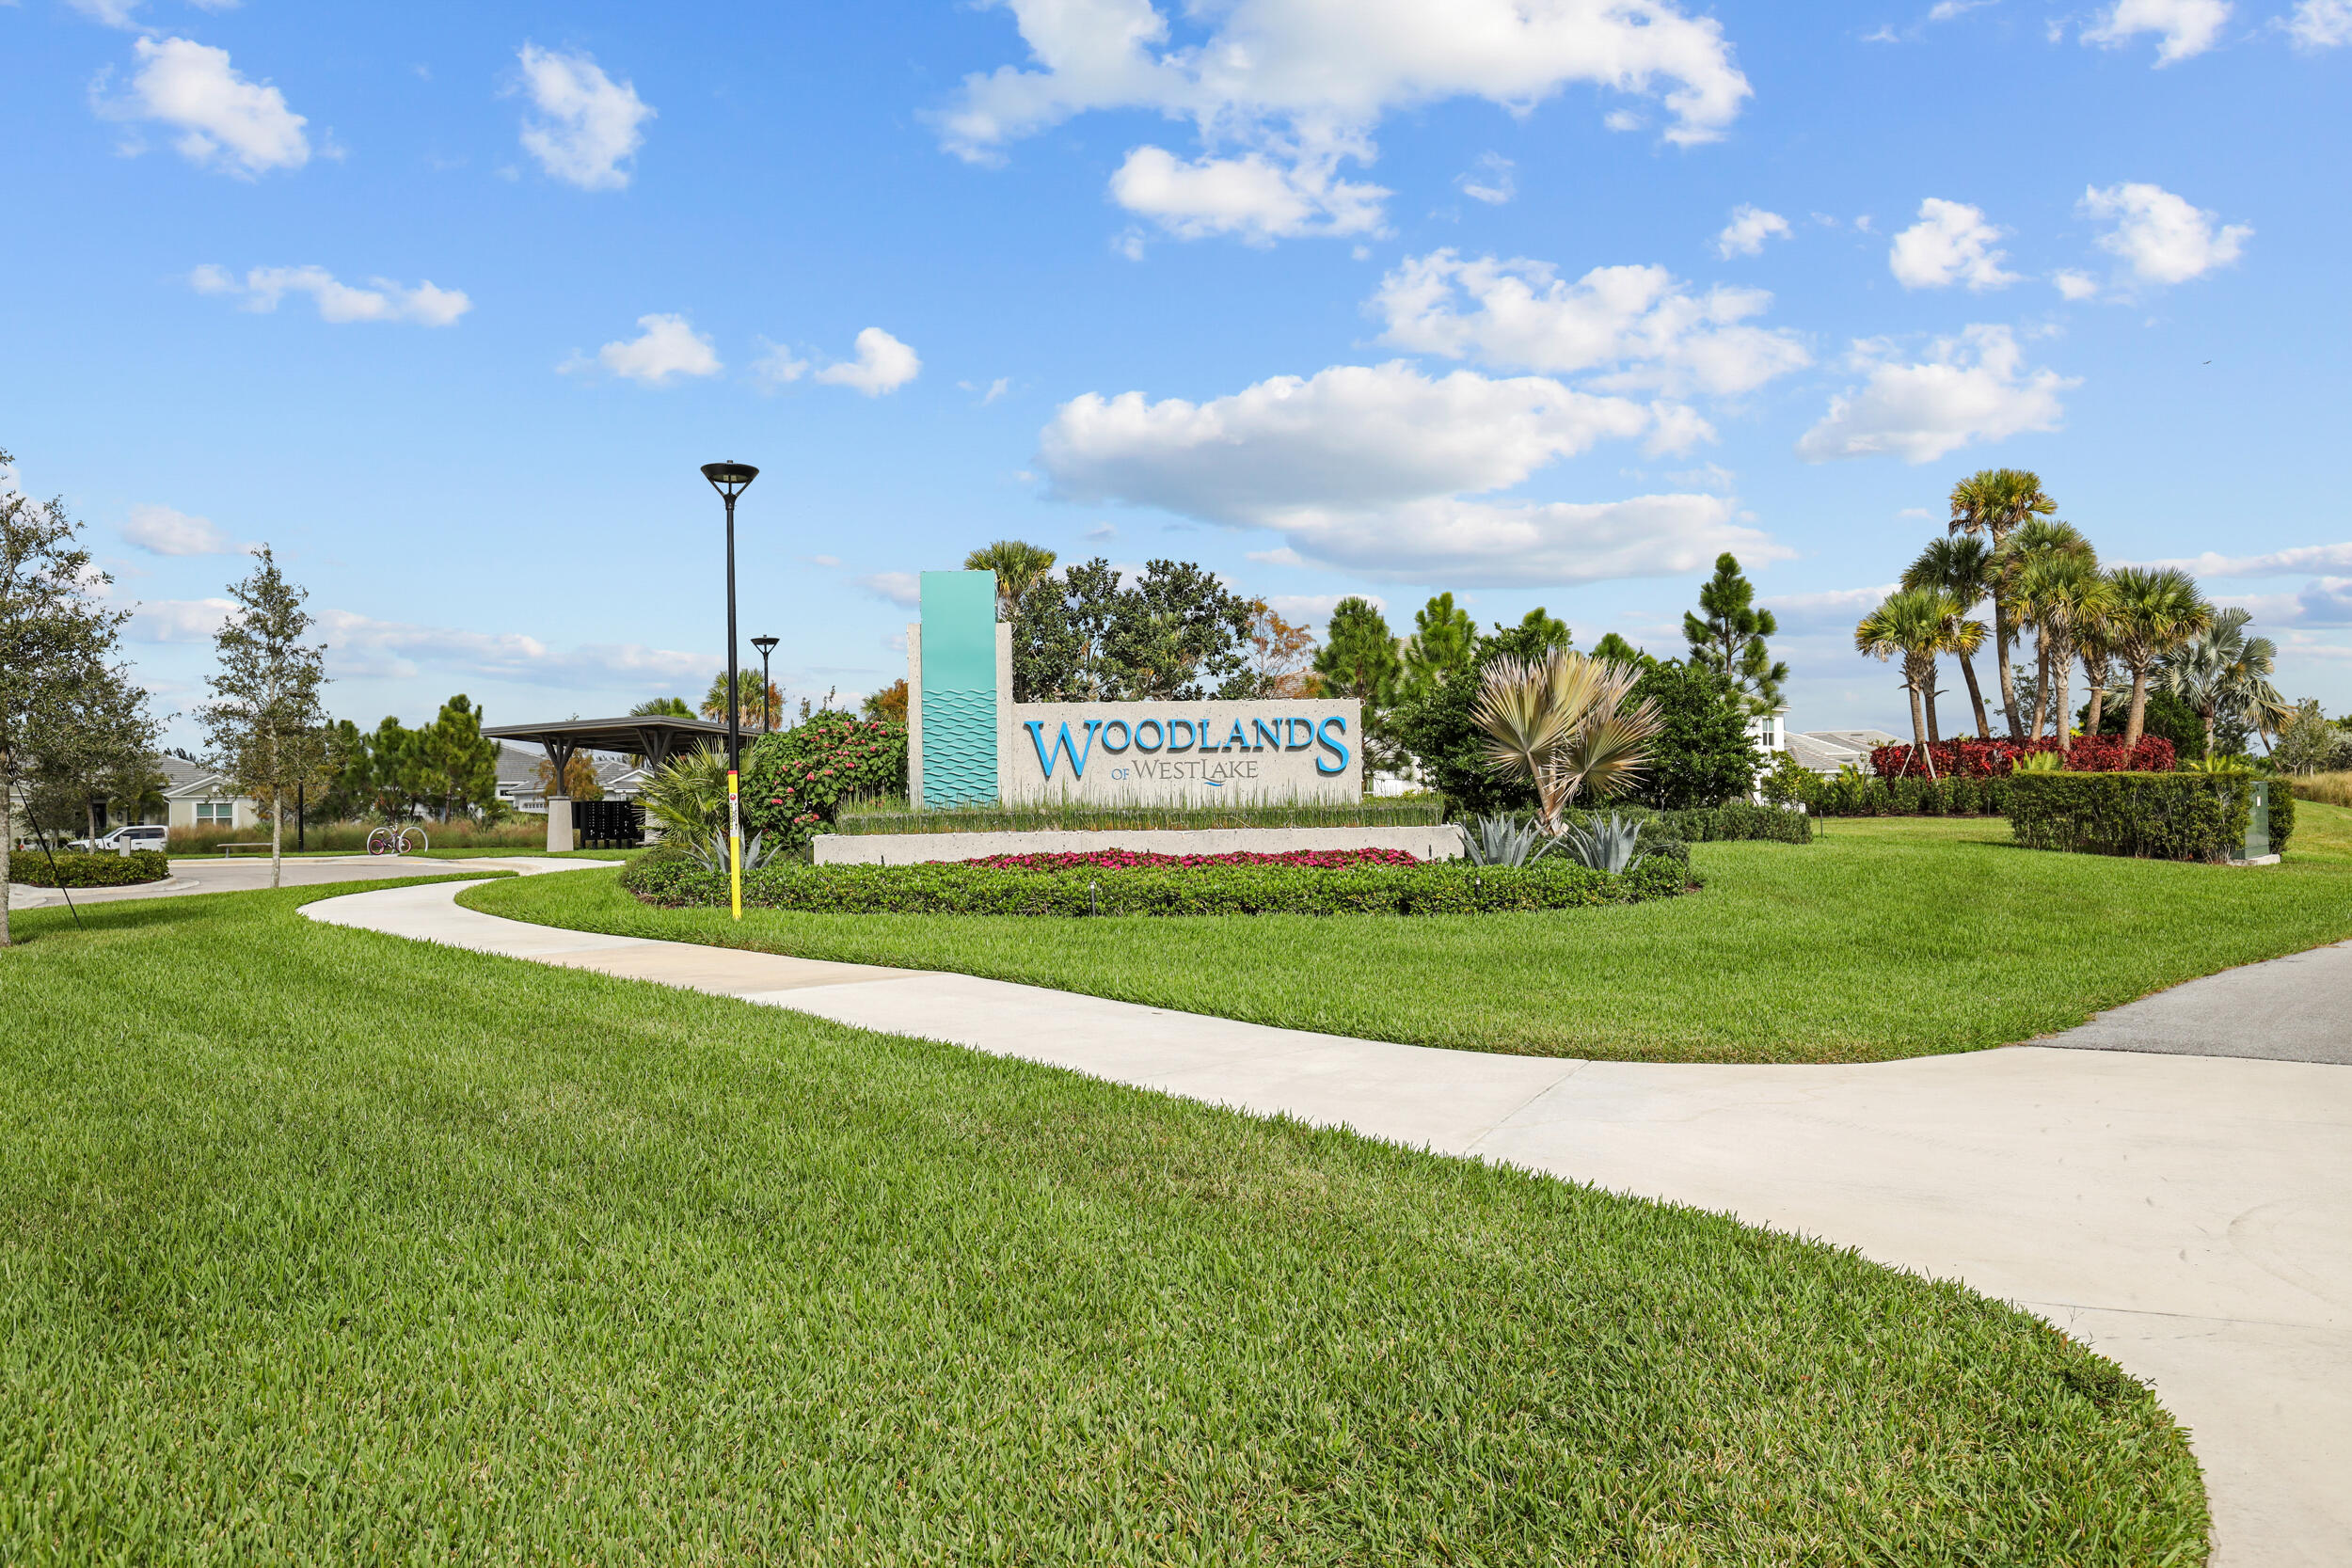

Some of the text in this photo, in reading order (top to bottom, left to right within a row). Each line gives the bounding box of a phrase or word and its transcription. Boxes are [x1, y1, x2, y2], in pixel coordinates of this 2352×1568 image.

[1024, 716, 1350, 779] WOODLANDS
[1111, 758, 1259, 782] OF WESTLAKE
